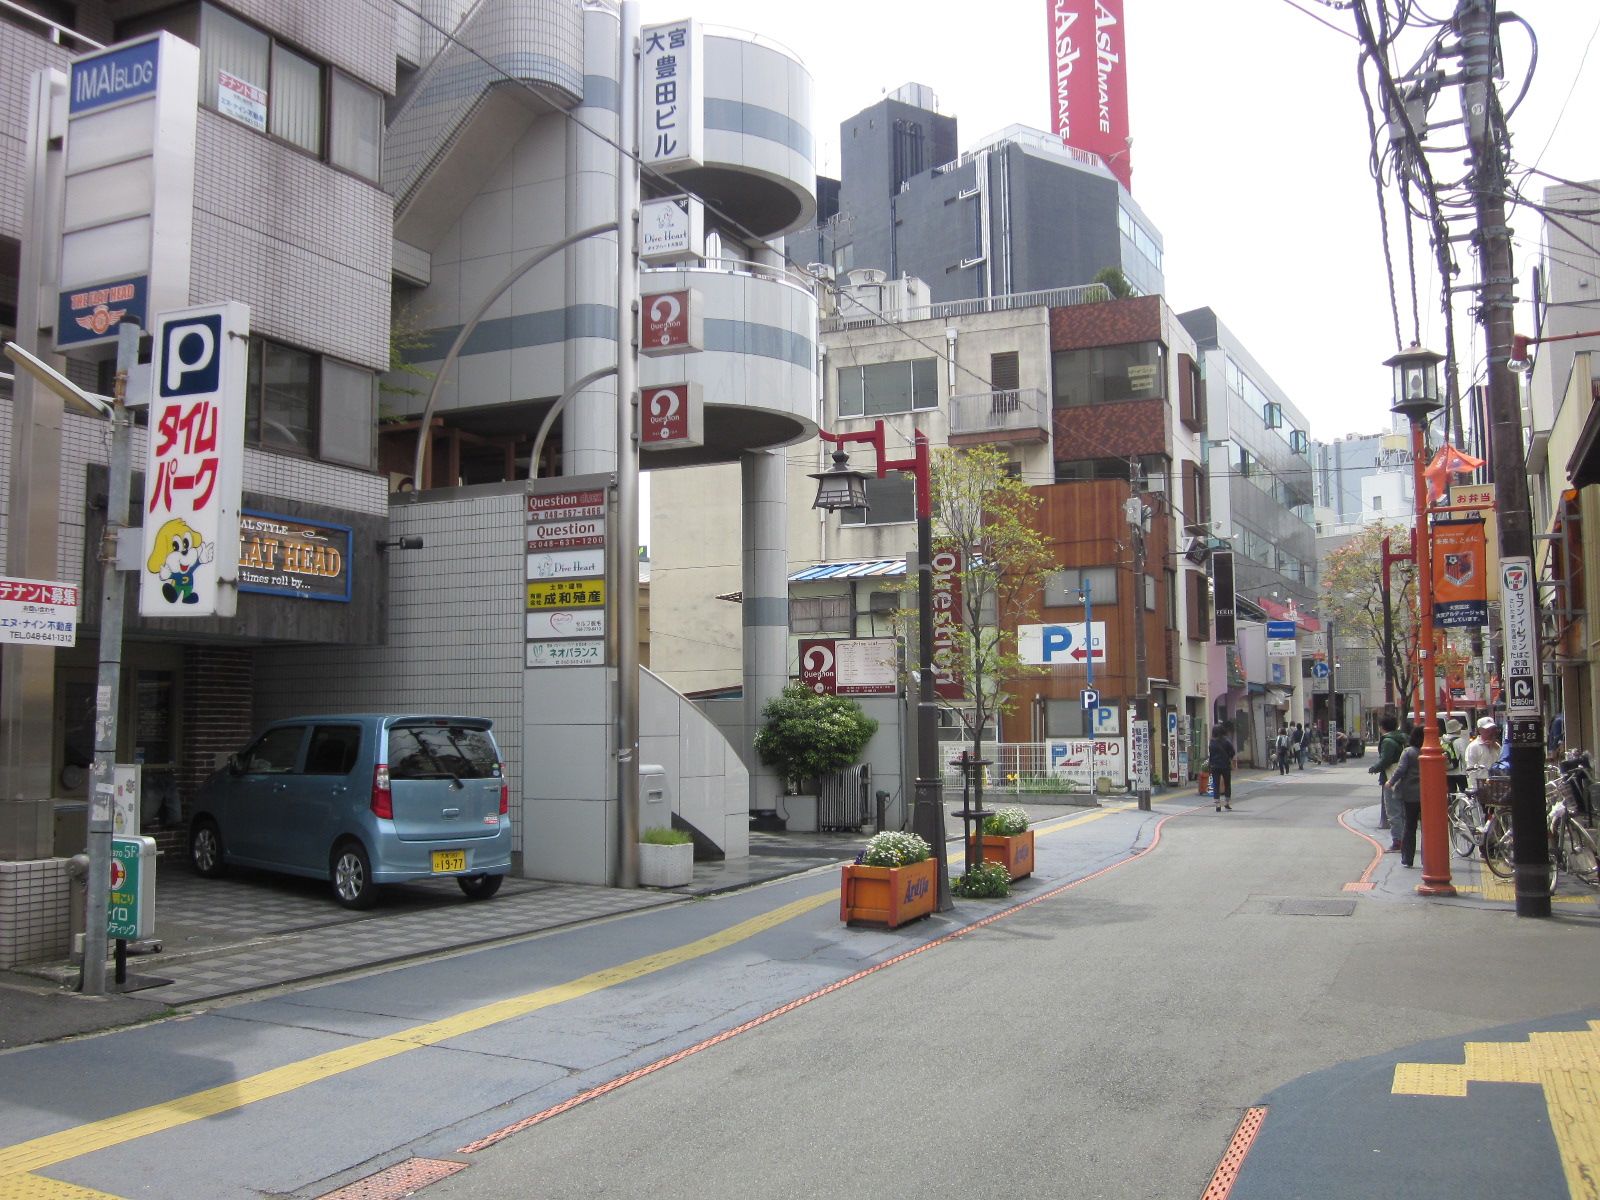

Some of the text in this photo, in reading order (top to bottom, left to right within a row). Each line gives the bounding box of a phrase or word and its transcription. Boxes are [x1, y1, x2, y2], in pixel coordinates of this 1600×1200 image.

[646, 28, 687, 54] 大宮
[655, 54, 677, 158] 豊田ビル
[679, 199, 688, 208] 3F
[167, 323, 214, 391] P
[155, 401, 218, 457] タイム
[149, 457, 218, 514] パーク
[530, 495, 577, 510] Question
[1456, 492, 1490, 504] お弁当
[255, 521, 288, 535] STYLE
[537, 523, 595, 539] Question
[538, 536, 603, 548] 048-631-1200
[283, 540, 341, 578] HEAD
[242, 571, 269, 584] times
[271, 574, 289, 586] roll
[0, 583, 76, 605] テナント募集
[549, 647, 598, 658] ネオバランス
[1042, 626, 1073, 663] P
[1511, 667, 1531, 675] ATM
[1513, 659, 1528, 667] お酒
[1084, 691, 1097, 709] P
[1098, 707, 1112, 726] P
[1169, 714, 1177, 733] P
